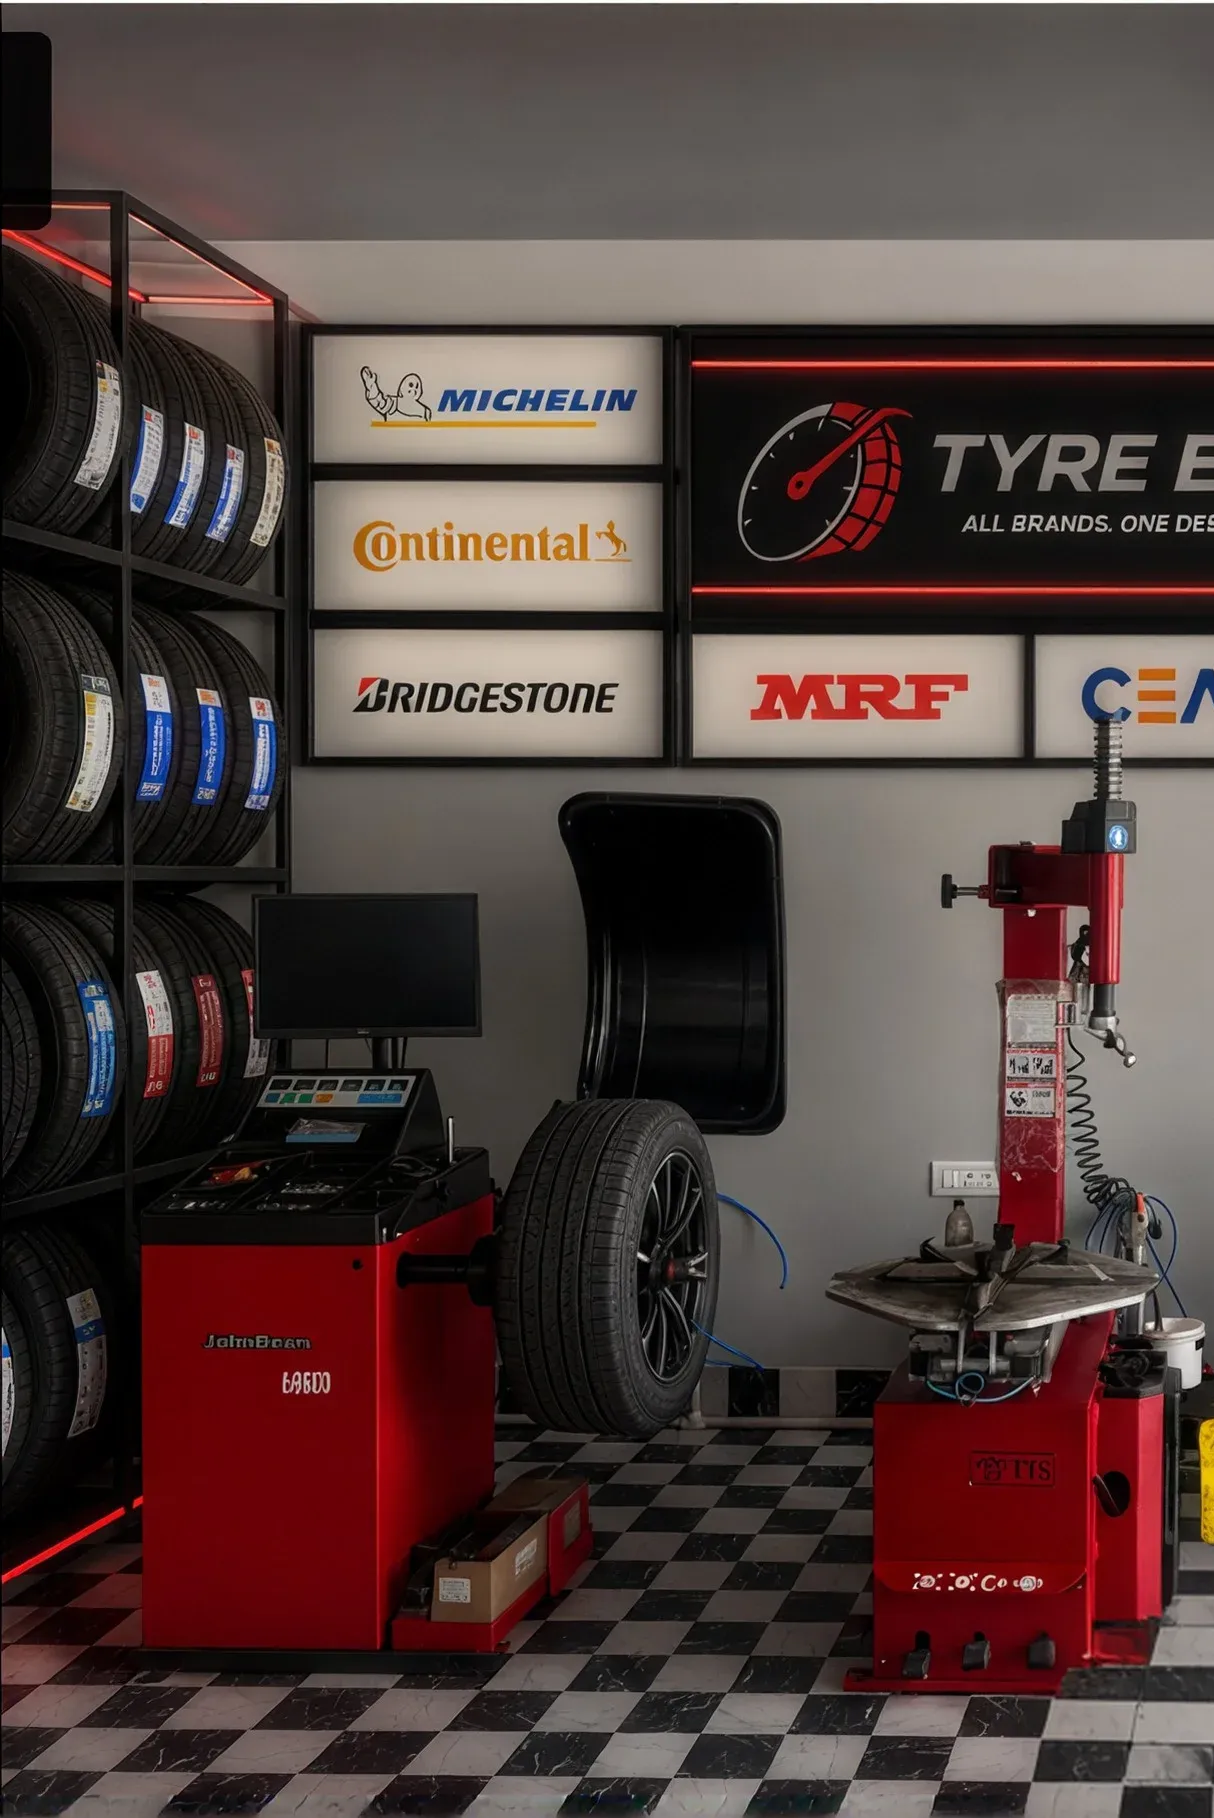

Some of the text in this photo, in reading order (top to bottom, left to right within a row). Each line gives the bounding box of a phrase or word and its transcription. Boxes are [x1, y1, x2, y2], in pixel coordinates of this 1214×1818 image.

[437, 388, 638, 412] MICHELIN
[933, 433, 1158, 492] TYRE
[961, 514, 1005, 532] ALL
[1011, 514, 1113, 532] BRANDS.
[1120, 514, 1170, 533] ONE
[353, 520, 591, 572] Continental
[352, 677, 619, 713] BRIDGESTONE
[750, 674, 968, 720] MRF
